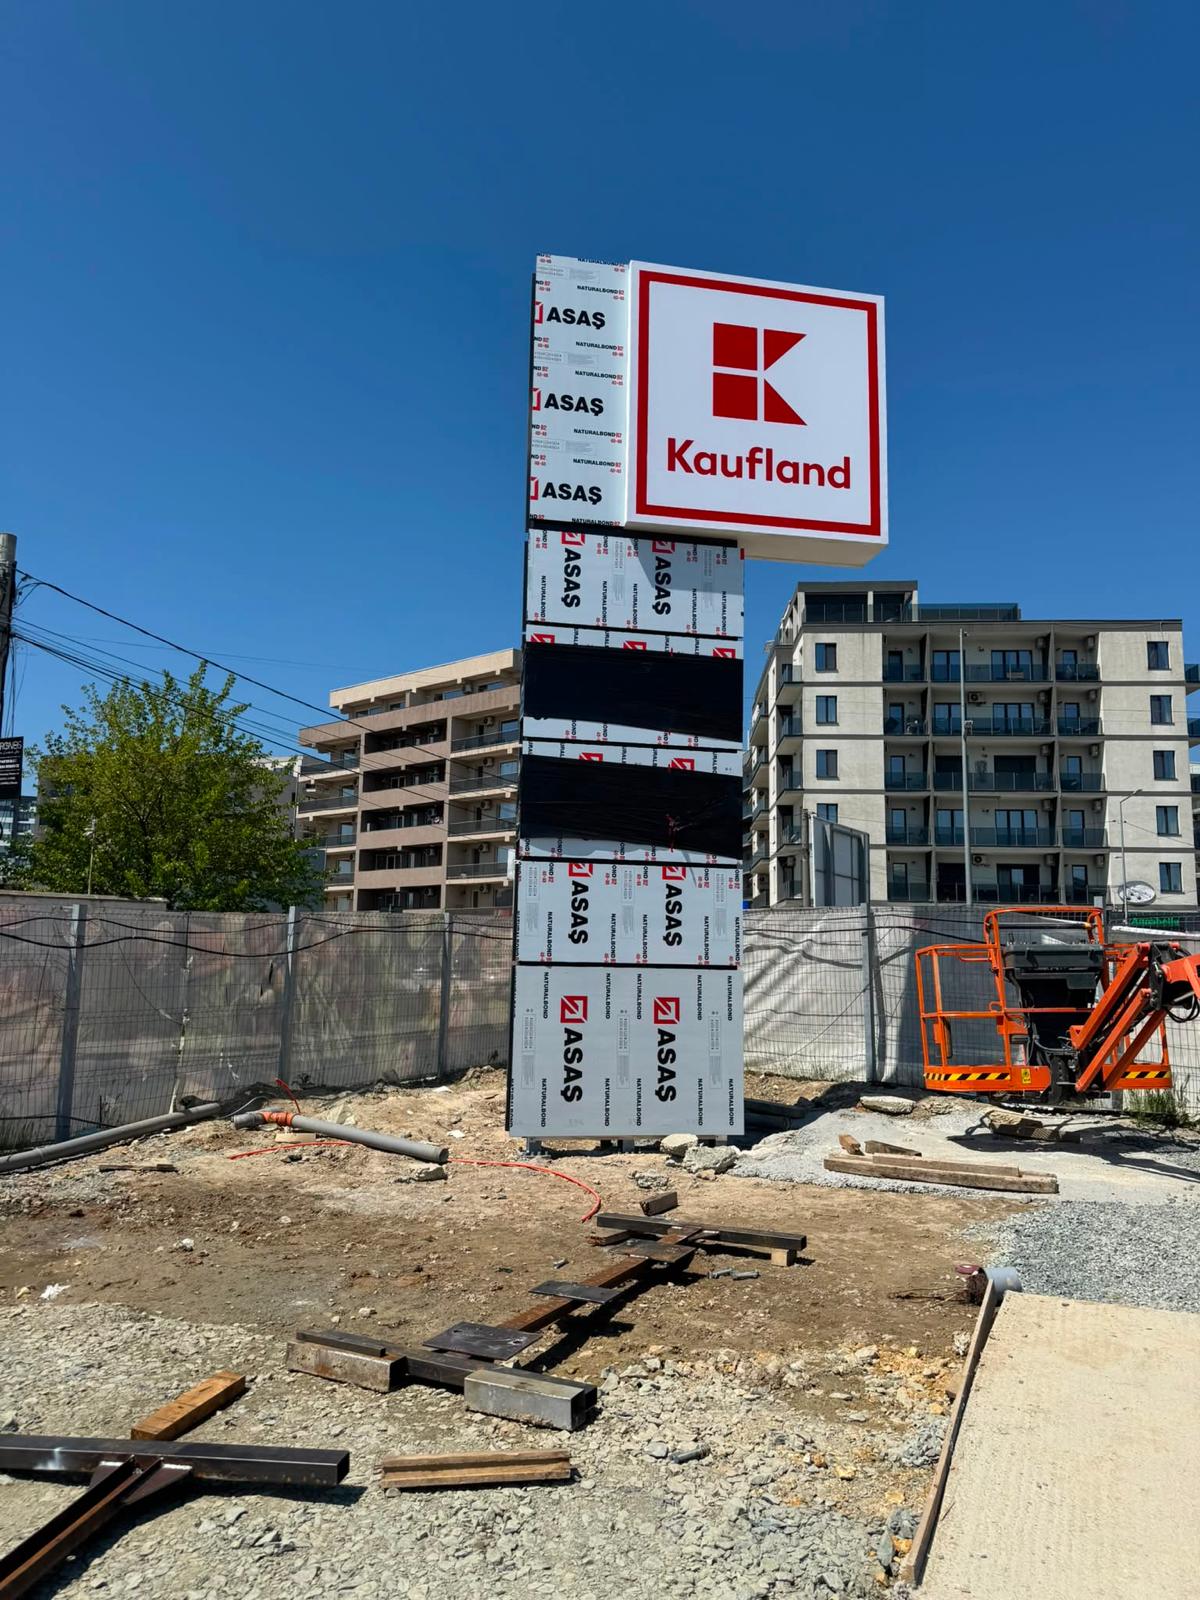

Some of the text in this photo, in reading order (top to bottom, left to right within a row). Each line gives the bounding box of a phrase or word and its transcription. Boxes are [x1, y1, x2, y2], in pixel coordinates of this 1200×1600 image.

[577, 285, 618, 294] NATURALBOND
[547, 307, 606, 330] ASAŞ
[576, 341, 617, 350] NATURALBOND
[575, 370, 617, 380] NATURALBOND
[544, 393, 604, 416] ASAŞ
[574, 428, 616, 437] NATURALBOND
[573, 458, 615, 467] NATURALBOND
[667, 438, 851, 490] Kaufland
[542, 482, 603, 505] ASAŞ
[561, 548, 582, 608] ASAŞ
[652, 556, 672, 615] ASAŞ
[568, 880, 589, 945] ASAŞ
[663, 883, 683, 947] ASAŞ
[560, 1027, 583, 1103] ASAŞ
[655, 1028, 677, 1102] ASAŞ
